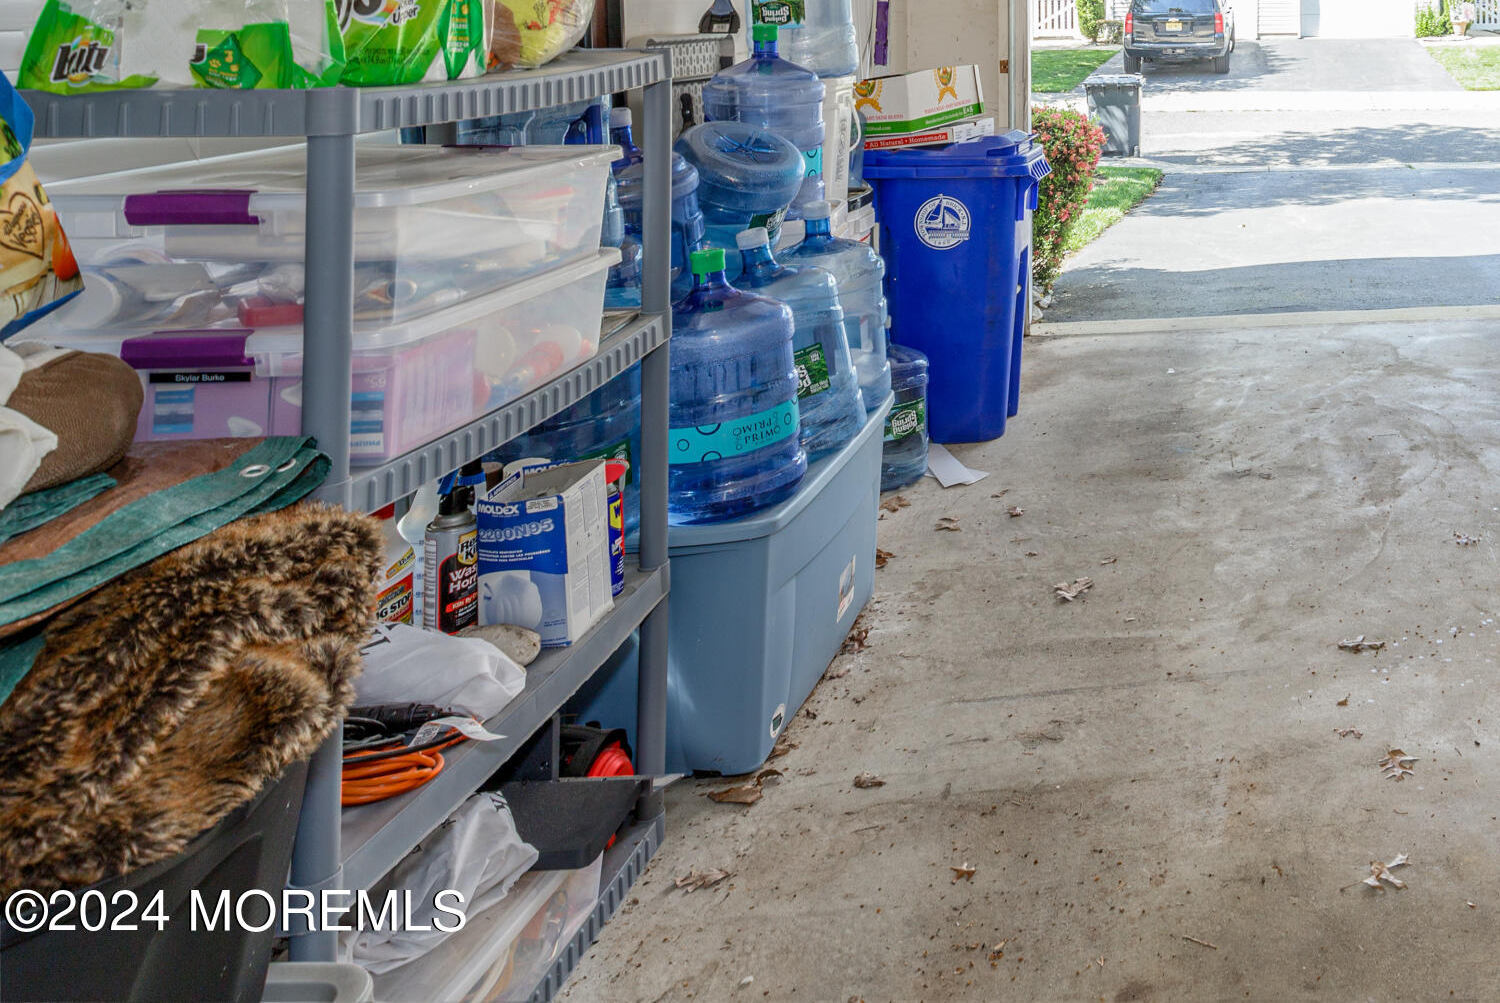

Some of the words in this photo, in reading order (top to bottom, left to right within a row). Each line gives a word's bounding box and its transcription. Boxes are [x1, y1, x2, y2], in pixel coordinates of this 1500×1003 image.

[762, 6, 789, 17] Spring
[869, 140, 879, 148] All
[880, 138, 904, 147] Natural
[909, 134, 947, 144] Homemade
[175, 374, 200, 383] Skylar
[202, 374, 225, 382] Burke
[478, 503, 520, 515] MOLDEX
[479, 518, 555, 543] 2200N95
[389, 591, 412, 613] STOP
